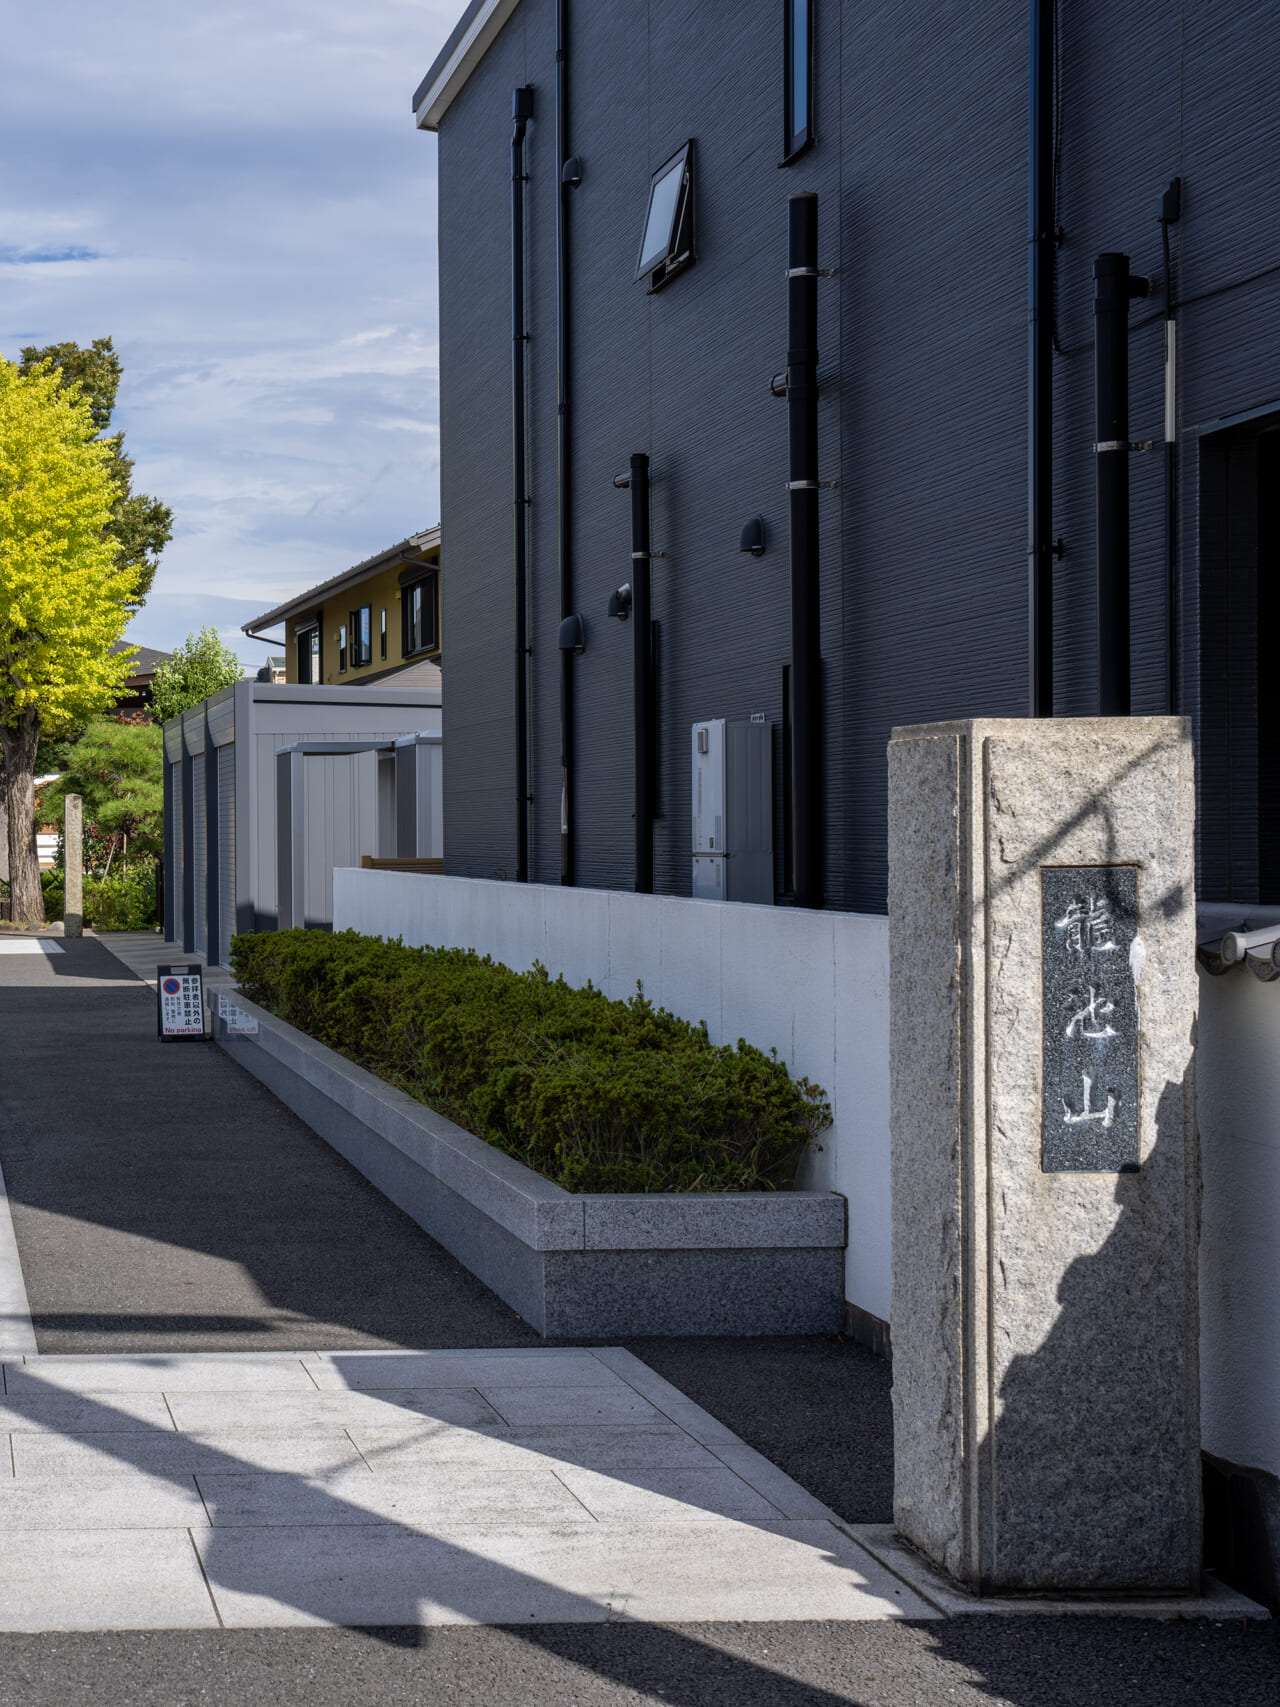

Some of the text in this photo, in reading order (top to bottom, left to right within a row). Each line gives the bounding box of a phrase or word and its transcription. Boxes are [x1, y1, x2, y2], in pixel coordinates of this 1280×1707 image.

[182, 977, 192, 1026] 無断駐車禁止
[1054, 893, 1120, 1127] 龍池山
